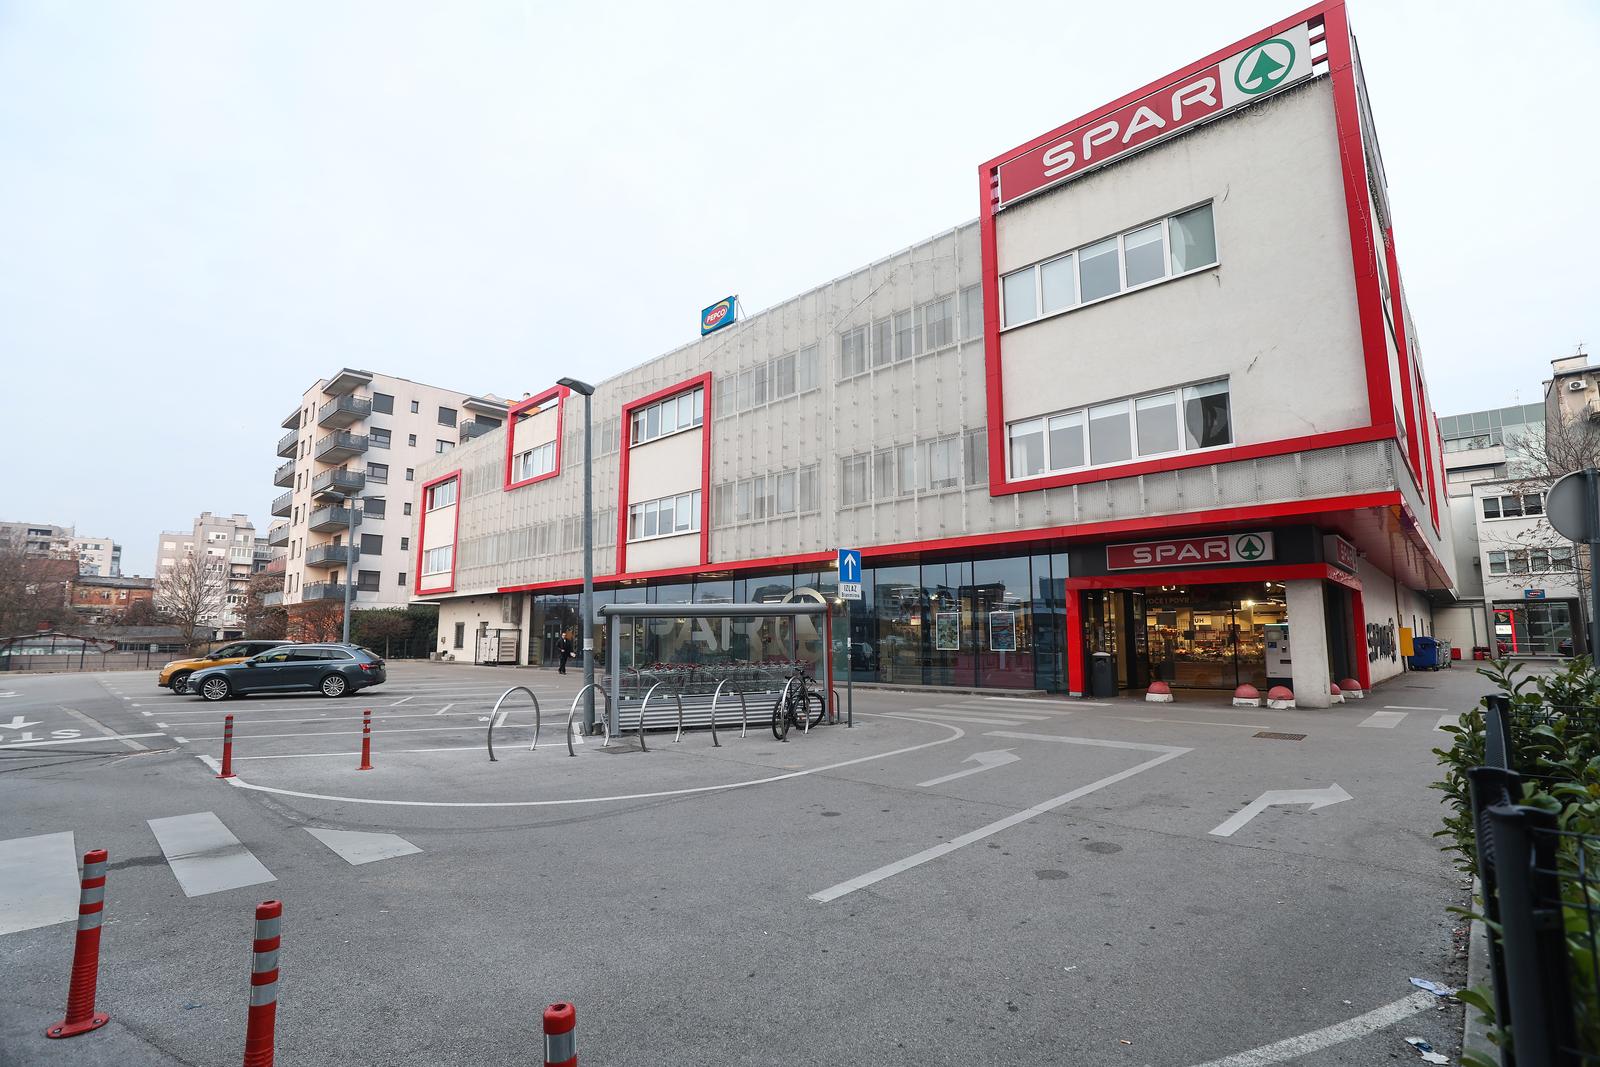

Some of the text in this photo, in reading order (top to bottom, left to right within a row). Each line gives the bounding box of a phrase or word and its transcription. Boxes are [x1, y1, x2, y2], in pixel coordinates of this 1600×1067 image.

[1042, 76, 1217, 177] SPAR
[706, 308, 726, 323] PEPCO
[1133, 540, 1227, 563] SPAR
[843, 584, 857, 592] IZLAZ
